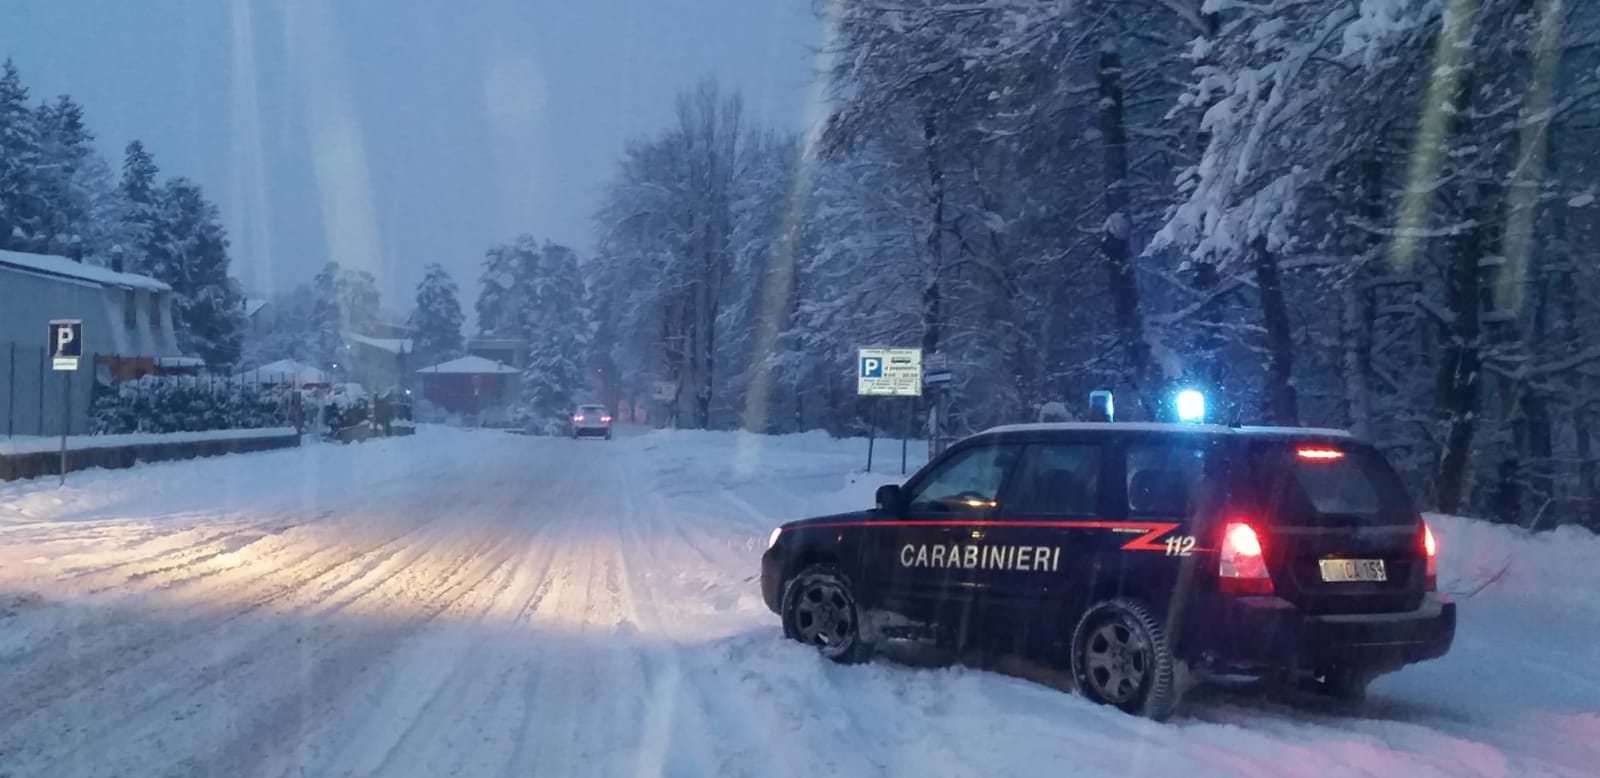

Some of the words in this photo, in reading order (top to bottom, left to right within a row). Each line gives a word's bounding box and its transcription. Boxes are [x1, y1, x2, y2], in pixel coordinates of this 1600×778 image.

[58, 327, 74, 351] P
[865, 359, 879, 376] P
[1165, 536, 1196, 556] 112
[900, 544, 1061, 571] CARABINIERI
